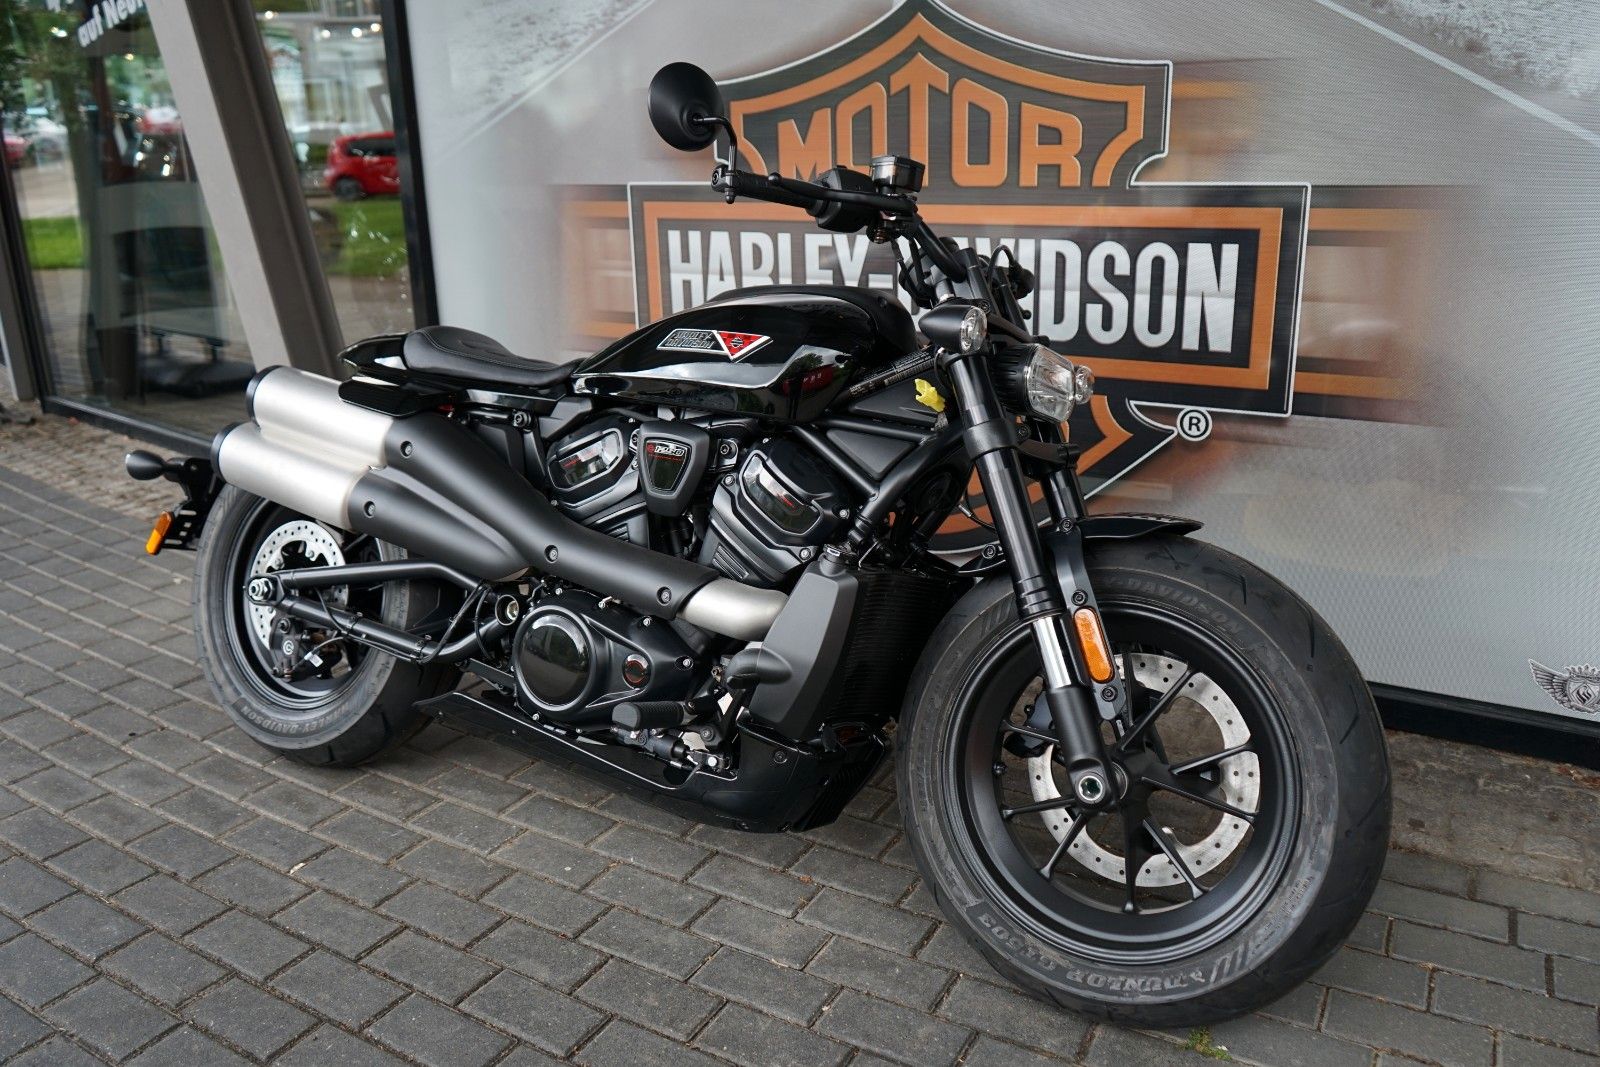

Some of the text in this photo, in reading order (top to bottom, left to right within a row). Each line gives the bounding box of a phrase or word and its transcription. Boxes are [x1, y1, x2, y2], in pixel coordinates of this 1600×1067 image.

[776, 52, 1083, 188] MOTOR
[666, 228, 1239, 353] HAREY-IDSON
[664, 338, 716, 349] DAVIDSON
[1065, 968, 1189, 993] DUNLOP
